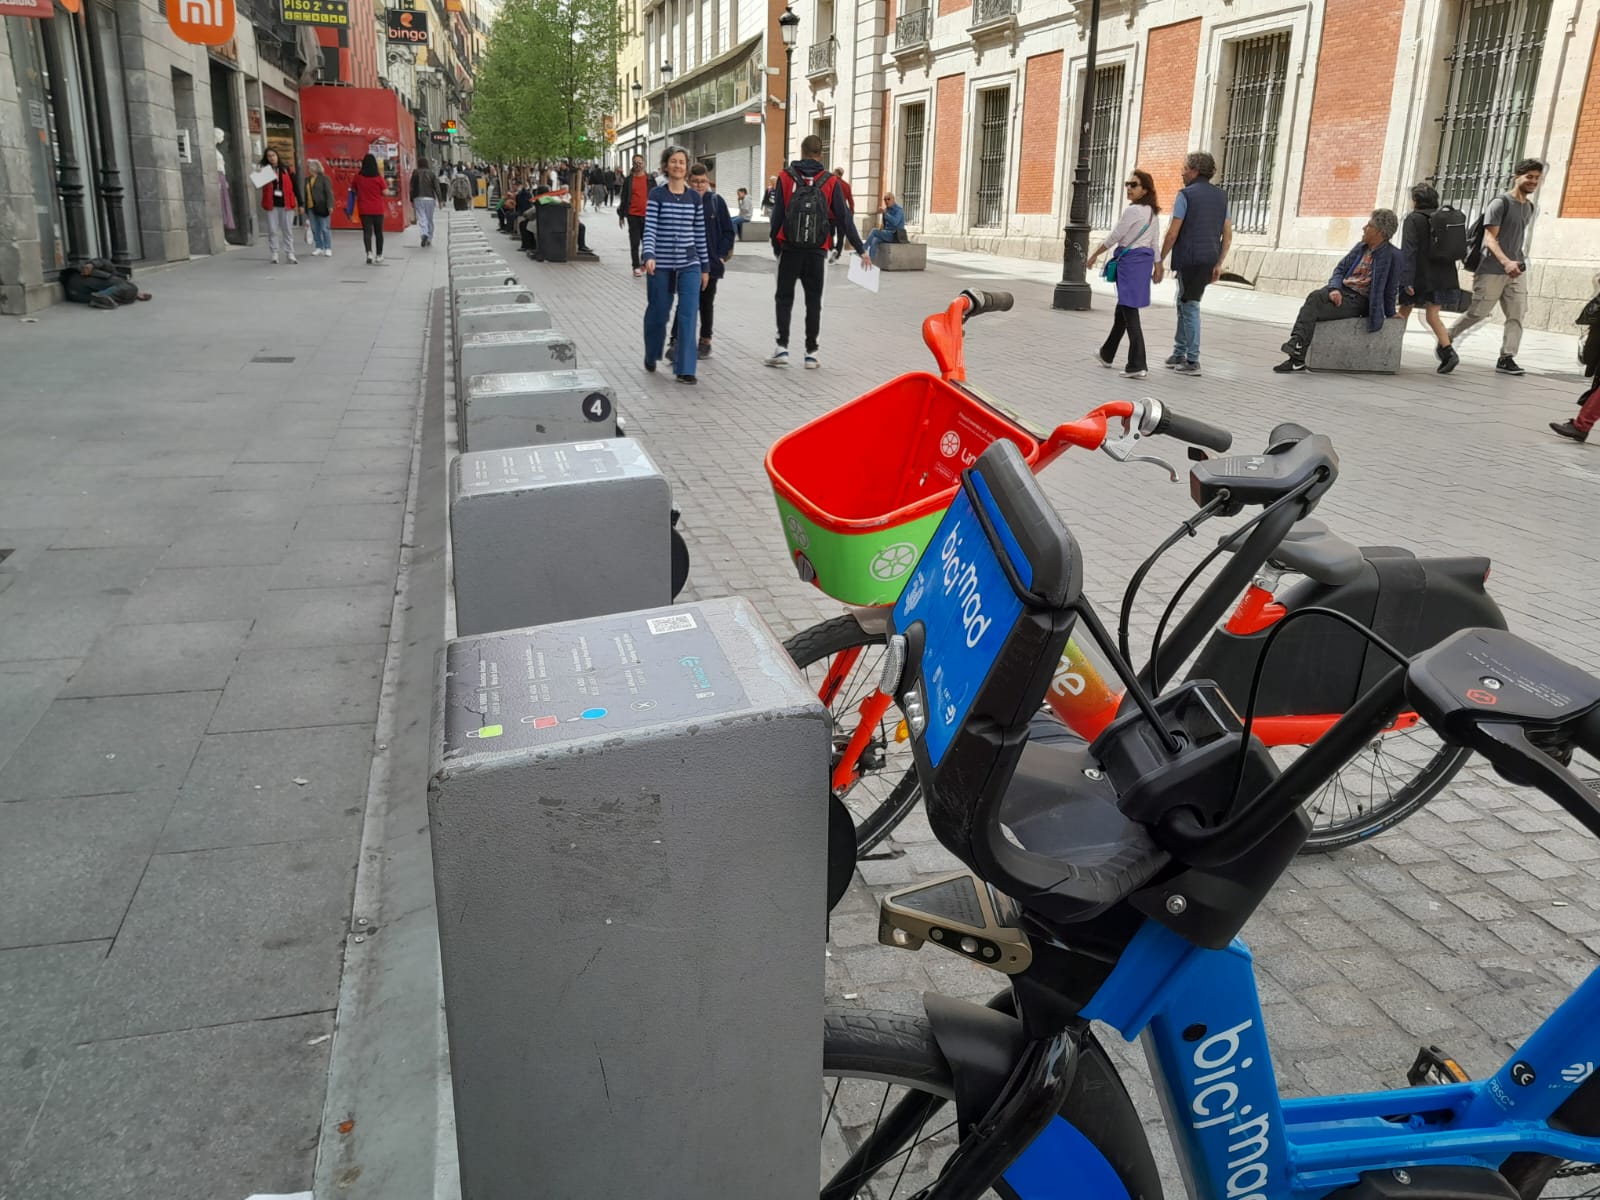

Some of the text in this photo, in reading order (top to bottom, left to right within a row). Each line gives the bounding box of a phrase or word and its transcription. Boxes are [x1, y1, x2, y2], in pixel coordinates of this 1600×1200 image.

[284, 0, 311, 11] PISO
[388, 27, 428, 42] bingo
[590, 399, 603, 416] 4
[1513, 1063, 1535, 1086] CE
[1193, 1019, 1270, 1200] bicima
